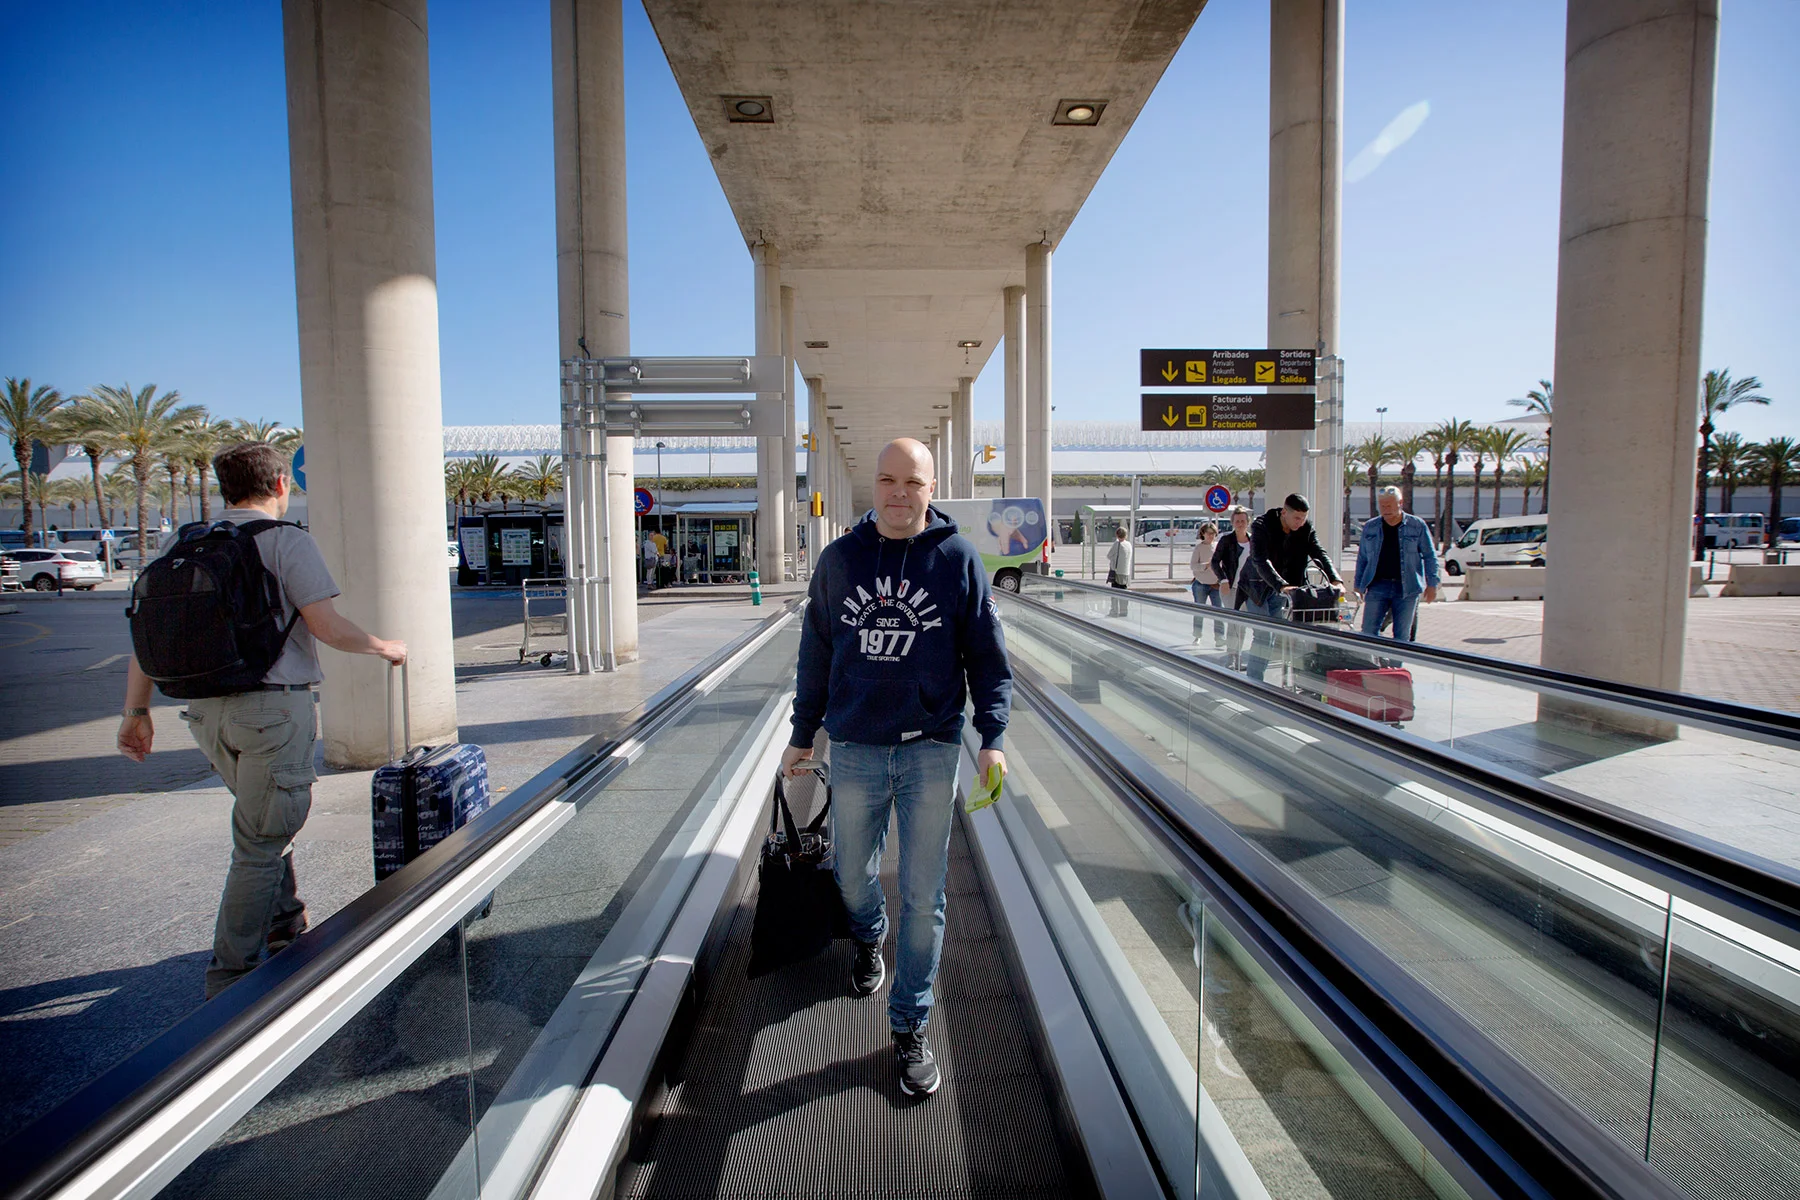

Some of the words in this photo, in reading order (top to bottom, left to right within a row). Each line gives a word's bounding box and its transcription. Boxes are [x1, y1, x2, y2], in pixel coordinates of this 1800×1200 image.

[1280, 350, 1311, 358] Sortides
[1280, 367, 1298, 375] Abflug
[1212, 376, 1247, 384] Llegadas
[1280, 375, 1307, 383] Salidas
[1212, 395, 1252, 403] Facturació
[1212, 420, 1257, 428] Facturación
[840, 575, 942, 632] CHAMONIX
[858, 602, 877, 627] STATE
[878, 599, 895, 607] THE
[895, 600, 919, 627] OBVIOUS
[876, 617, 900, 628] SINCE
[858, 628, 916, 656] 1977
